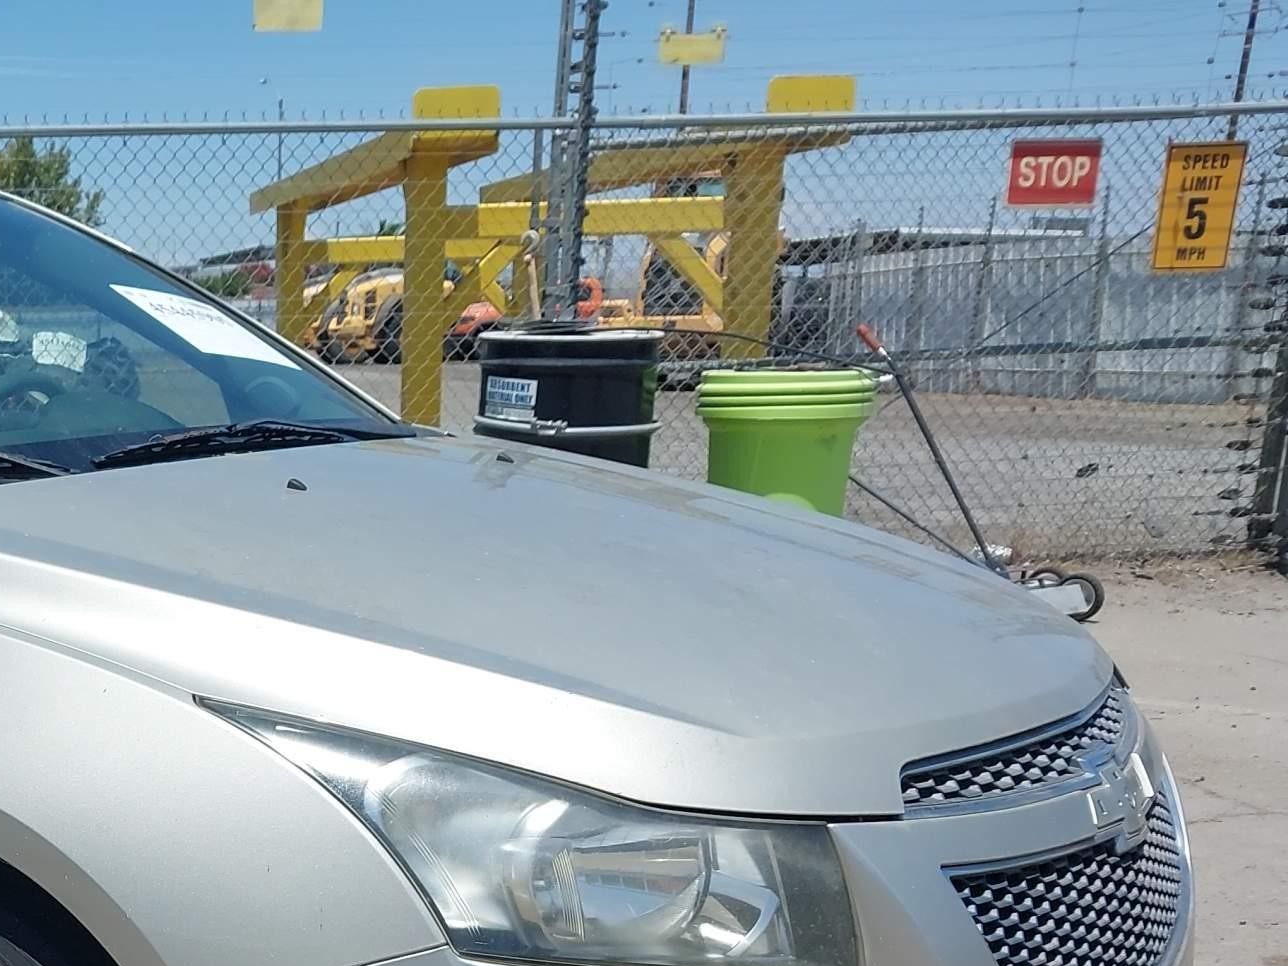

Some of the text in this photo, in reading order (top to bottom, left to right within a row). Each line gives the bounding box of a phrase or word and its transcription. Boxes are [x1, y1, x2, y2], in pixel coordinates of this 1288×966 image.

[1182, 153, 1230, 170] SPEED
[1018, 156, 1091, 188] STOP
[1181, 175, 1223, 192] LIMIT
[1183, 197, 1209, 240] 5
[1176, 247, 1206, 261] MPH
